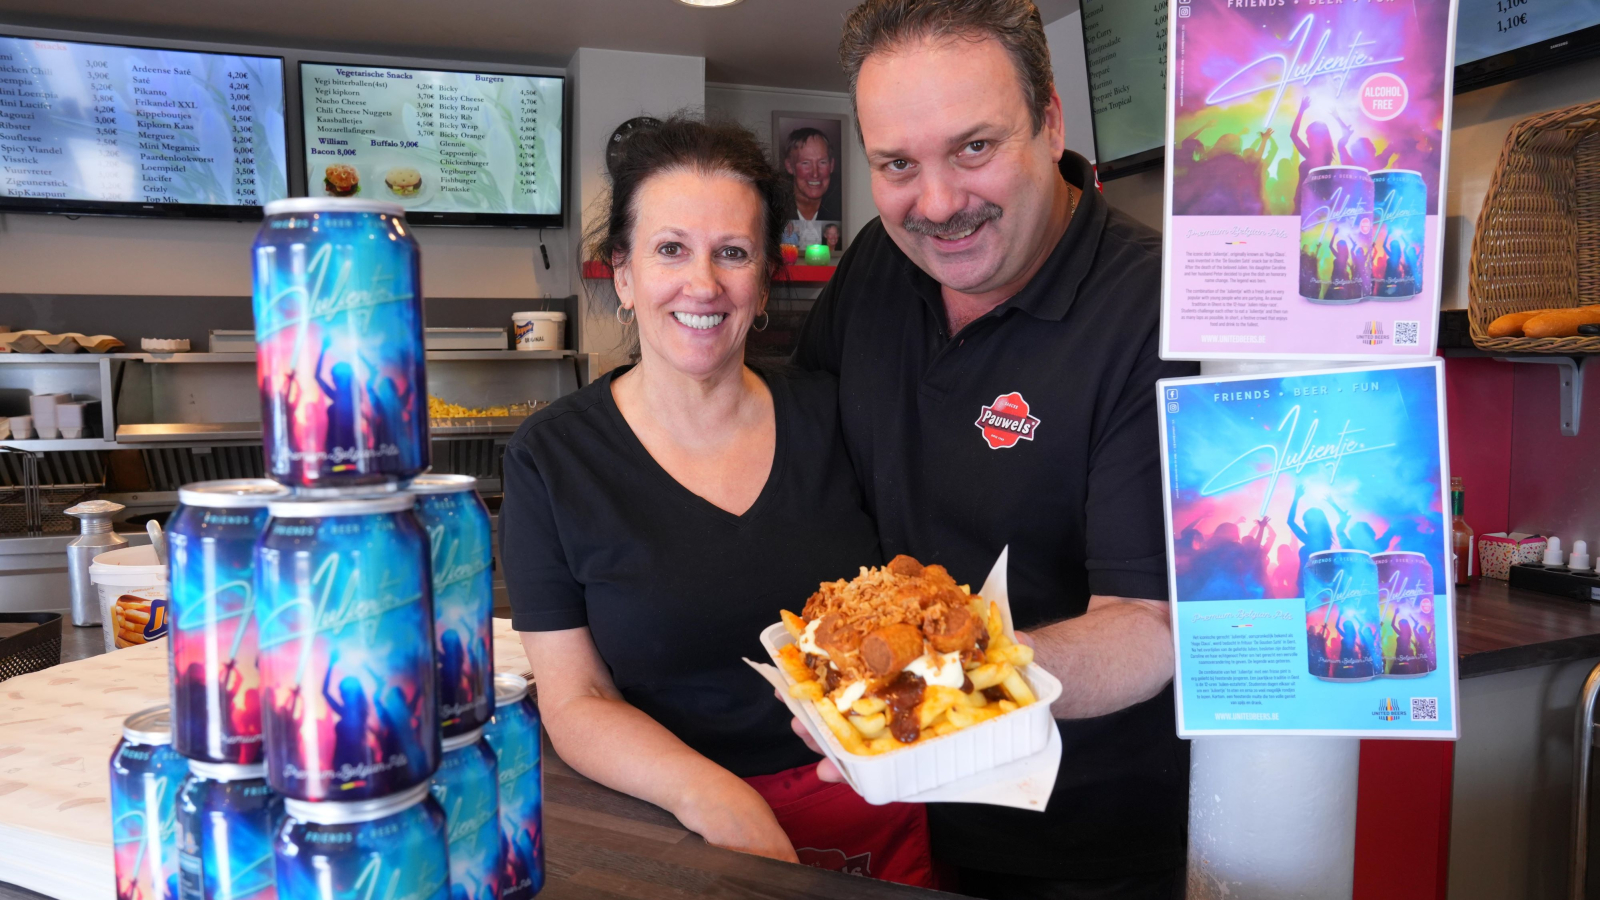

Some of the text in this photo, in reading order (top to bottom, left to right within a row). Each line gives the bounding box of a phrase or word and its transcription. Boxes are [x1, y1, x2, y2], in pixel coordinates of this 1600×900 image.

[1496, 0, 1528, 13] 1,10€
[1496, 12, 1528, 32] 1,10€
[1096, 28, 1112, 39] Curry
[34, 42, 67, 51] Snacks
[1550, 41, 1568, 50] SAMSUNG
[86, 60, 108, 68] 3,00€
[30, 67, 52, 76] Chili
[132, 64, 192, 76] Ardeense Saté
[336, 68, 413, 80] Vegetarische Snacks
[1090, 66, 1110, 80] Preparé
[88, 72, 110, 80] 3,90€
[132, 76, 150, 84] Saté
[228, 72, 248, 80] 4,20€
[475, 74, 504, 84] Burgers
[91, 83, 112, 91] 5,20€
[229, 82, 250, 90] 4,20€
[314, 78, 388, 89] Vegi bitterballen(4st)
[439, 84, 458, 92] Bicky
[1091, 80, 1112, 91] Martino
[18, 89, 58, 100] Loempia
[134, 87, 167, 96] Pikanto
[314, 88, 360, 97] Vegi kipkorn
[1092, 84, 1130, 104] Preparé Bicky
[1364, 86, 1402, 98] ALCOHOL
[92, 94, 114, 103] 3,80€
[230, 93, 250, 102] 3,00€
[20, 100, 52, 110] Lucifer
[135, 98, 198, 109] Frikandel XXL
[1109, 96, 1132, 110] Tropical
[1372, 99, 1394, 110] FREE
[94, 106, 116, 114] 4,20€
[231, 104, 252, 112] 4,00€
[439, 104, 458, 112] Bicky
[0, 110, 34, 120] Ragouzi
[136, 110, 192, 120] Kippeboutjes
[362, 109, 392, 118] Nuggets
[439, 113, 458, 121] Bicky
[94, 116, 116, 124] 3,00€
[232, 115, 252, 123] 4,50€
[316, 116, 362, 125] Kaasballetjes
[0, 122, 30, 130] Ribster
[137, 120, 194, 131] Kipkorn Kaas
[232, 126, 252, 134] 3,30€
[440, 122, 478, 131] Bicky Wrap
[96, 128, 118, 136] 3,50€
[317, 126, 376, 135] Mozarellafingers
[0, 132, 42, 142] Souflesse
[138, 132, 175, 142] Merguez
[232, 136, 253, 144] 4,20€
[440, 132, 486, 140] Bicky Orange
[318, 138, 348, 146] William
[370, 140, 419, 149] Buffalo 9,00€
[0, 144, 62, 154] Spicy Viandel
[139, 142, 200, 153] Mini Megamix
[234, 146, 254, 155] 6,00€
[311, 148, 356, 156] Bacon 8,00€
[440, 149, 478, 158] Cappoentje
[2, 155, 38, 164] Visstick
[140, 153, 214, 164] Paardenlookworst
[234, 158, 255, 166] 4,40€
[440, 158, 489, 168] Chickenburger
[4, 166, 52, 176] Vuurvreter
[141, 164, 186, 174] Loempidel
[236, 168, 255, 176] 3,50€
[440, 168, 477, 176] Vegiburger
[6, 177, 68, 188] Zigeunerstick
[142, 174, 172, 182] Lucifer
[236, 178, 256, 186] 3,50€
[440, 176, 477, 185] Fishburger
[8, 188, 66, 198] KipKaaspunt
[143, 185, 168, 194] Crizly
[236, 188, 256, 196] 4,50€
[144, 196, 160, 204] Top
[1186, 226, 1288, 238] Premium Belgian Pils
[1201, 335, 1266, 344] WWW.UNITEDBEERS.BE
[1214, 382, 1380, 402] FRIENDS BEER FUN
[982, 410, 1031, 434] Pauwels
[204, 514, 250, 525] FRIENDS
[274, 524, 360, 536] FRIENDS BEER
[1191, 610, 1293, 622] Premium Belgian Pils
[1215, 712, 1279, 720] WWW.UNITEDBEERS.BE
[304, 832, 353, 844] FRIENDS
